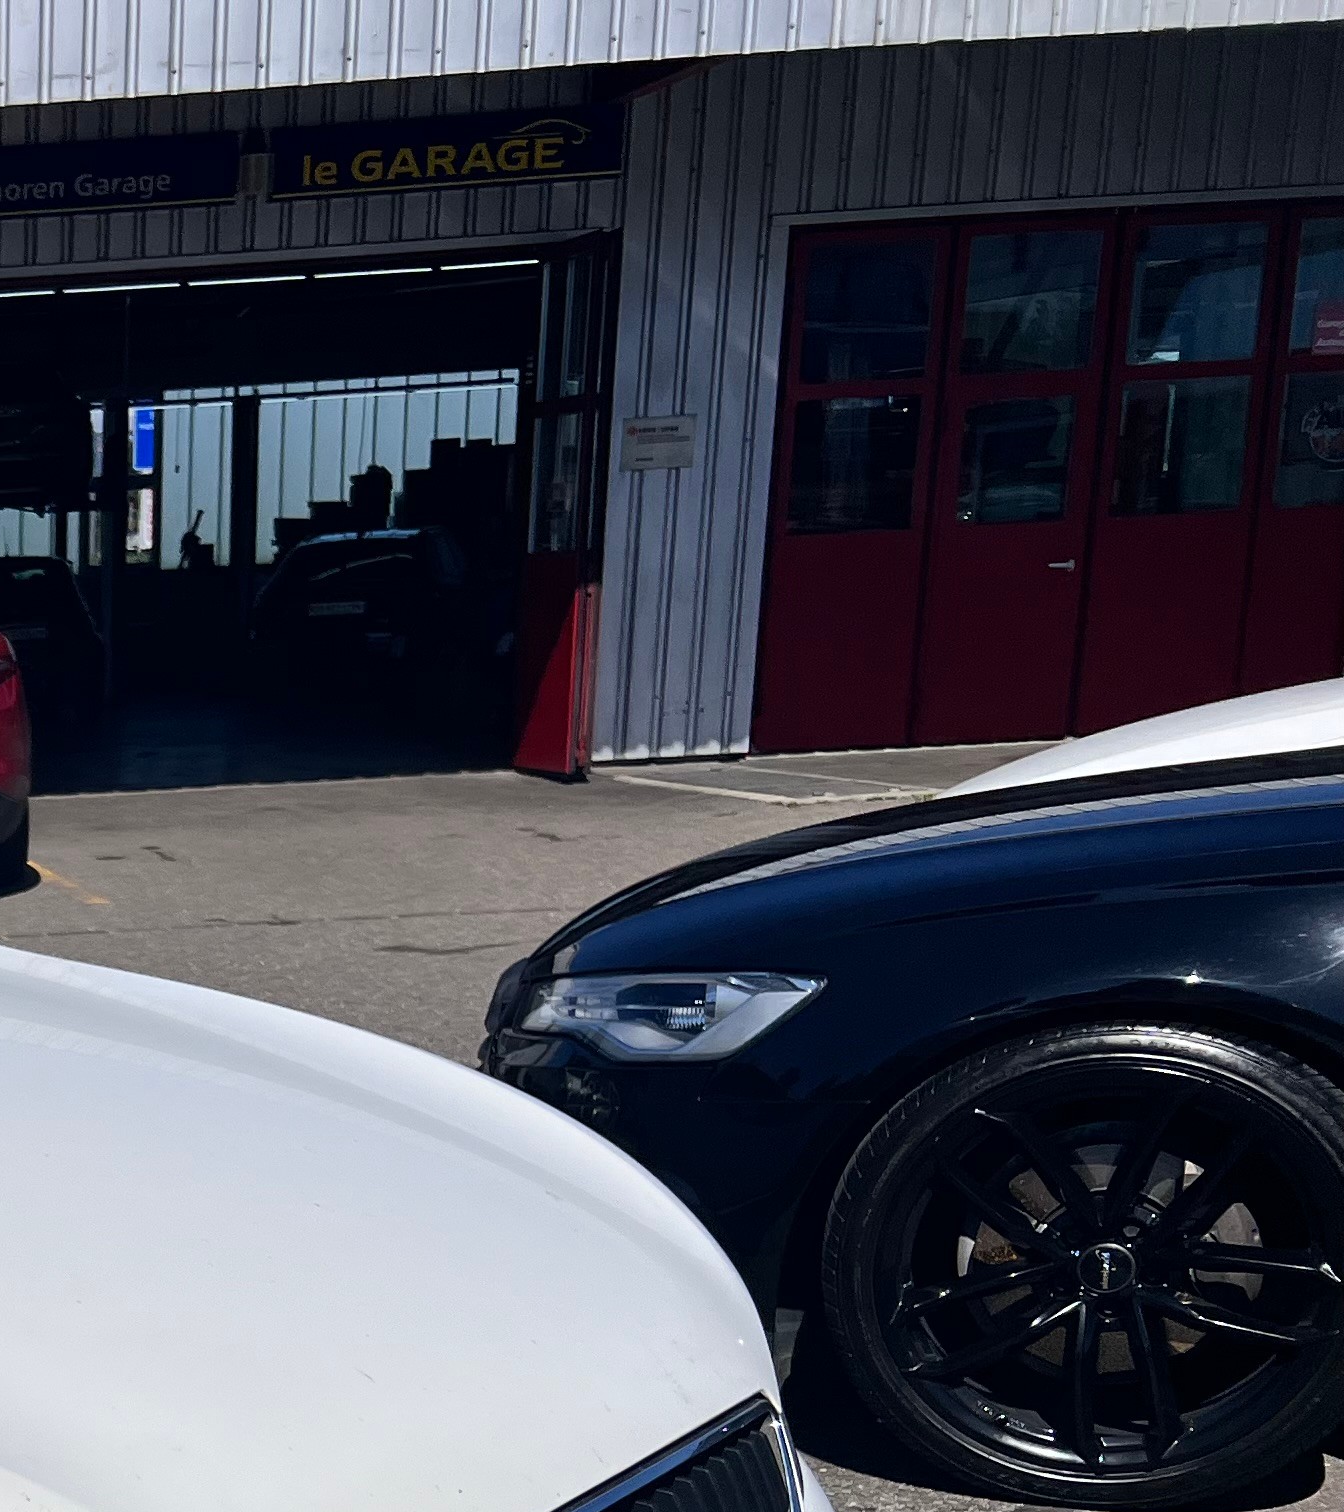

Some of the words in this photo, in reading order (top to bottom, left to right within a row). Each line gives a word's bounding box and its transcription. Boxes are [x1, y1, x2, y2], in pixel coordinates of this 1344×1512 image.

[301, 153, 338, 187] le
[351, 137, 565, 183] GARAGE
[73, 170, 172, 199] Garage
